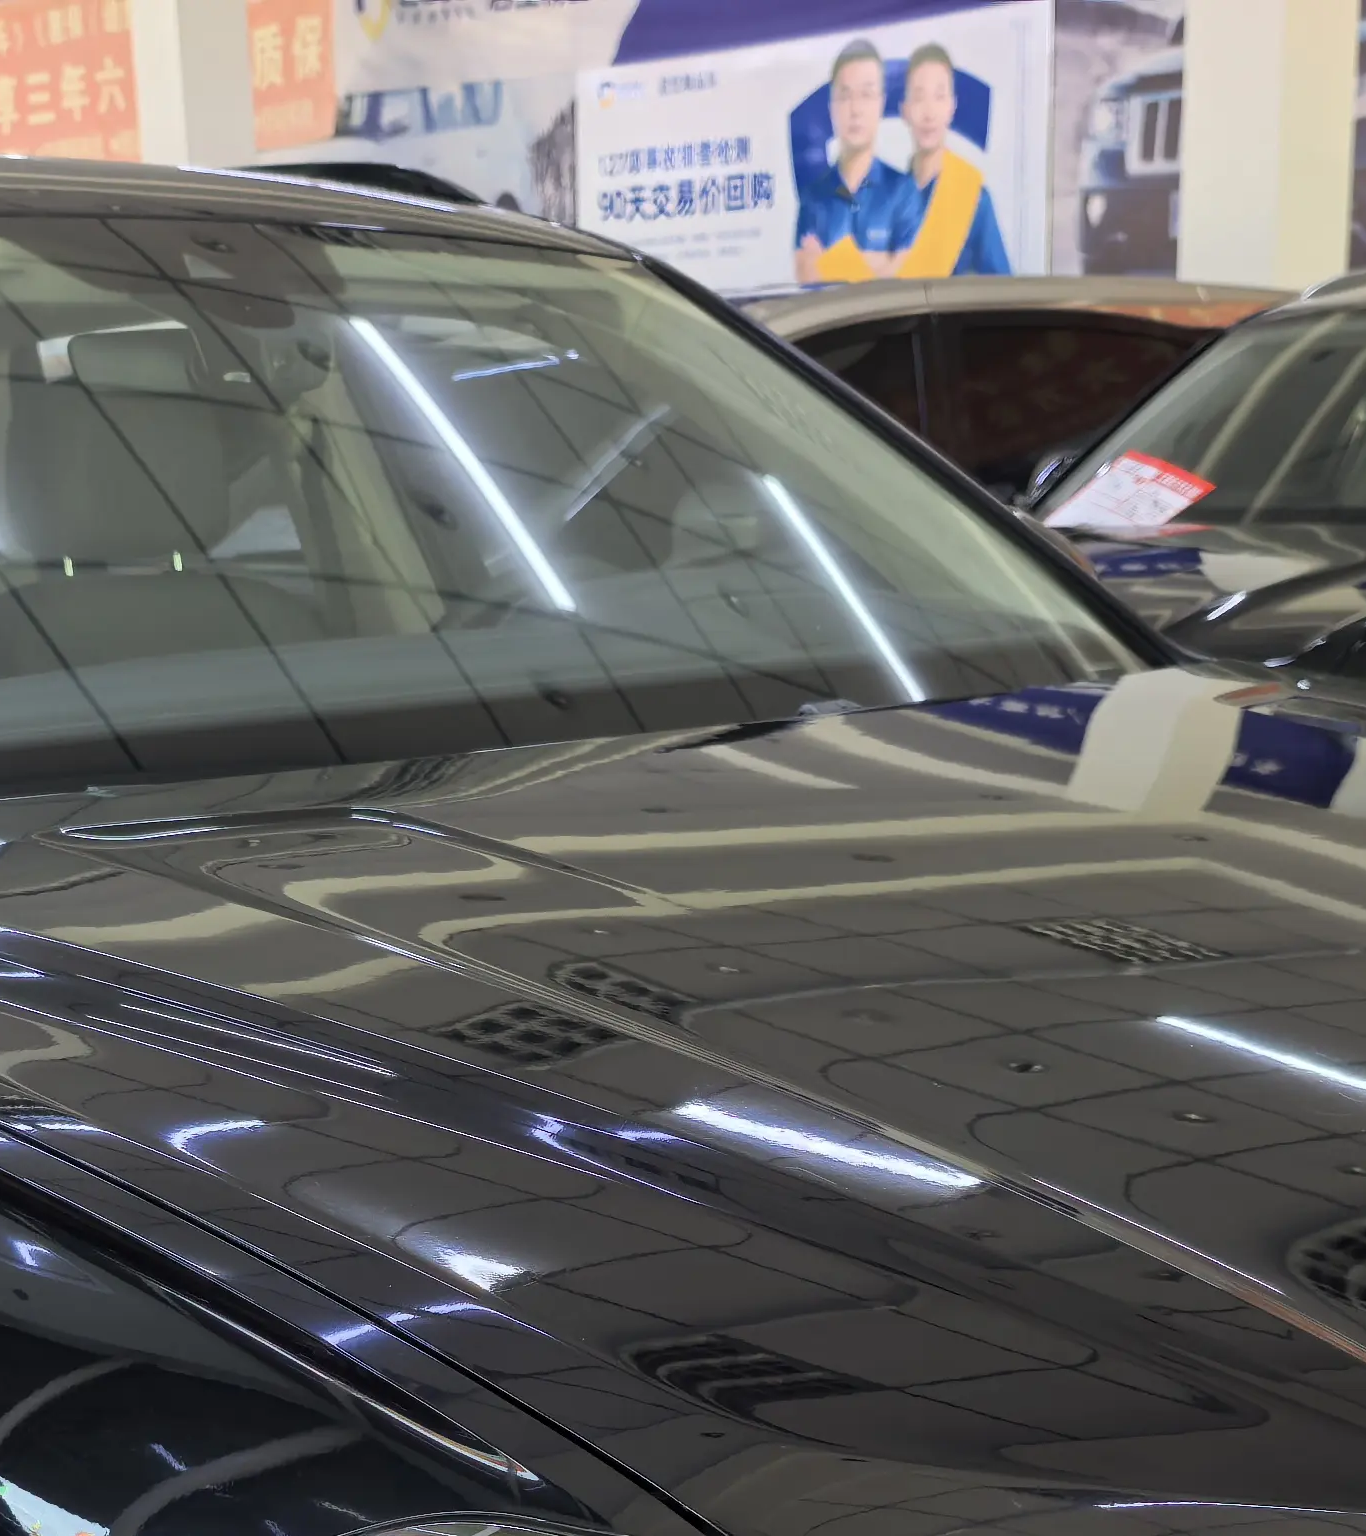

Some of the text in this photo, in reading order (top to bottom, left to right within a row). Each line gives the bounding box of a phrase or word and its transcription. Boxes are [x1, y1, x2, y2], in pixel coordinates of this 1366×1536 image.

[251, 15, 323, 91] 质保
[597, 173, 776, 223] 90天交易价回购
